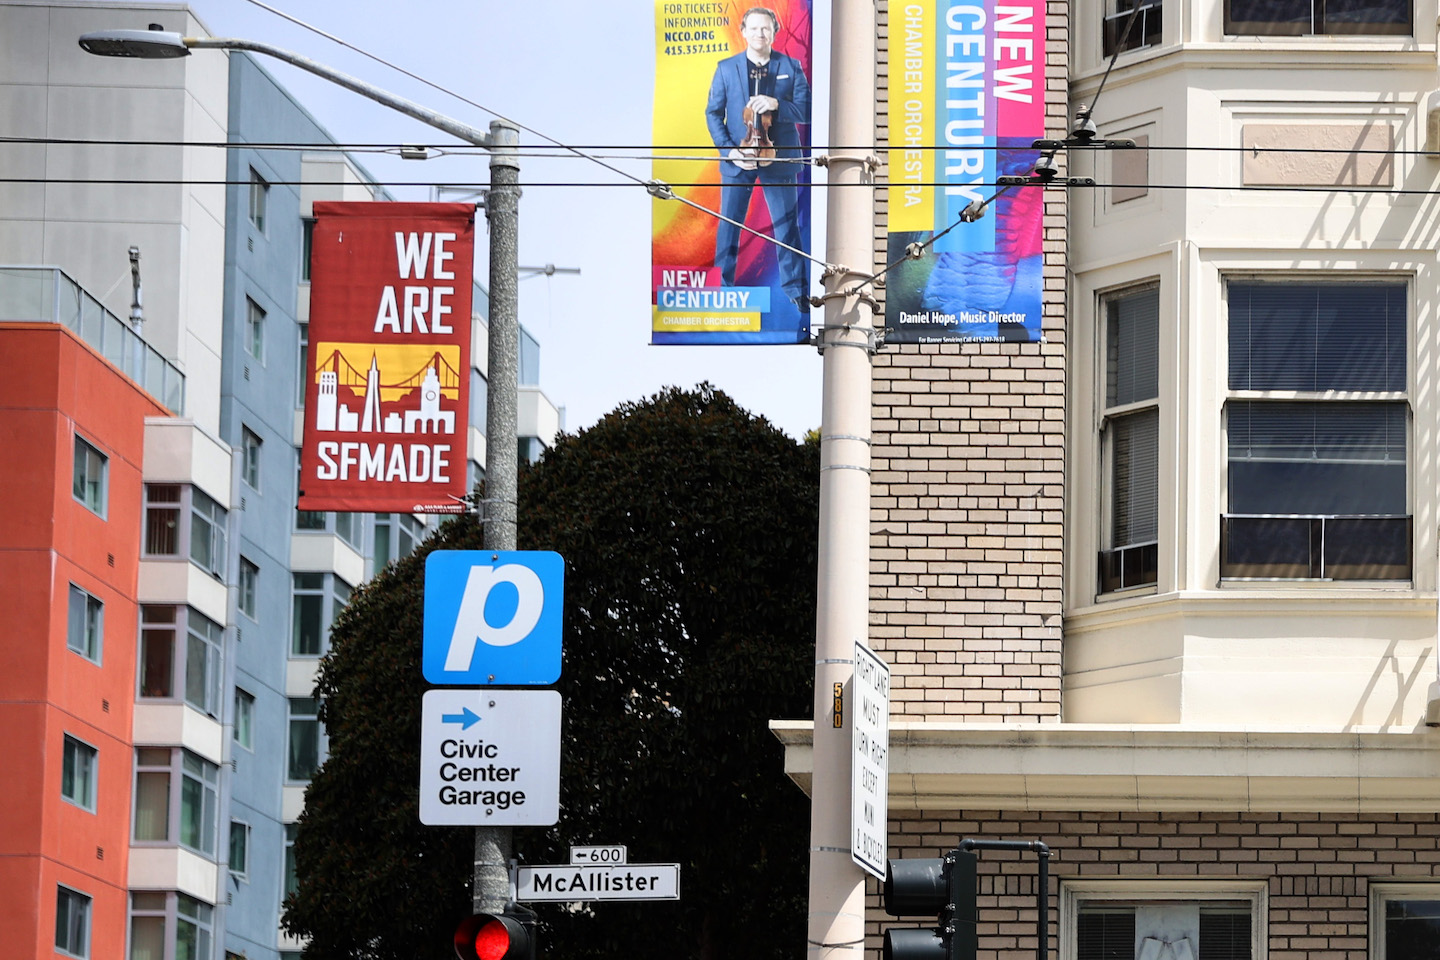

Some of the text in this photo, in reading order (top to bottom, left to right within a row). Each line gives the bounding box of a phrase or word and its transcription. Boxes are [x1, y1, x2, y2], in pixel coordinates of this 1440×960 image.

[664, 3, 683, 14] FOR
[664, 16, 730, 29] INFORMATION
[664, 30, 715, 42] NCCO.ORG
[664, 42, 729, 56] 415.357.1111
[993, 5, 1034, 104] NEW
[904, 4, 923, 208] CHAMBER ORCHESTRA
[945, 4, 987, 206] CENTURY
[395, 231, 456, 280] WE
[662, 269, 707, 289] NEW
[373, 285, 455, 334] ARE
[662, 289, 750, 309] CENTURY
[663, 316, 750, 326] CHAMBER ORCHESTRA
[899, 310, 1026, 326] Daniel Hope, Music Director
[316, 440, 451, 483] SFMADE
[857, 653, 888, 698] RIGHT LANE
[834, 682, 843, 728] 580
[863, 695, 879, 728] MUST
[440, 738, 499, 760] Civic
[439, 761, 521, 782] Center
[438, 785, 526, 810] Garage
[590, 849, 621, 862] 600
[533, 872, 659, 893] McAllister
